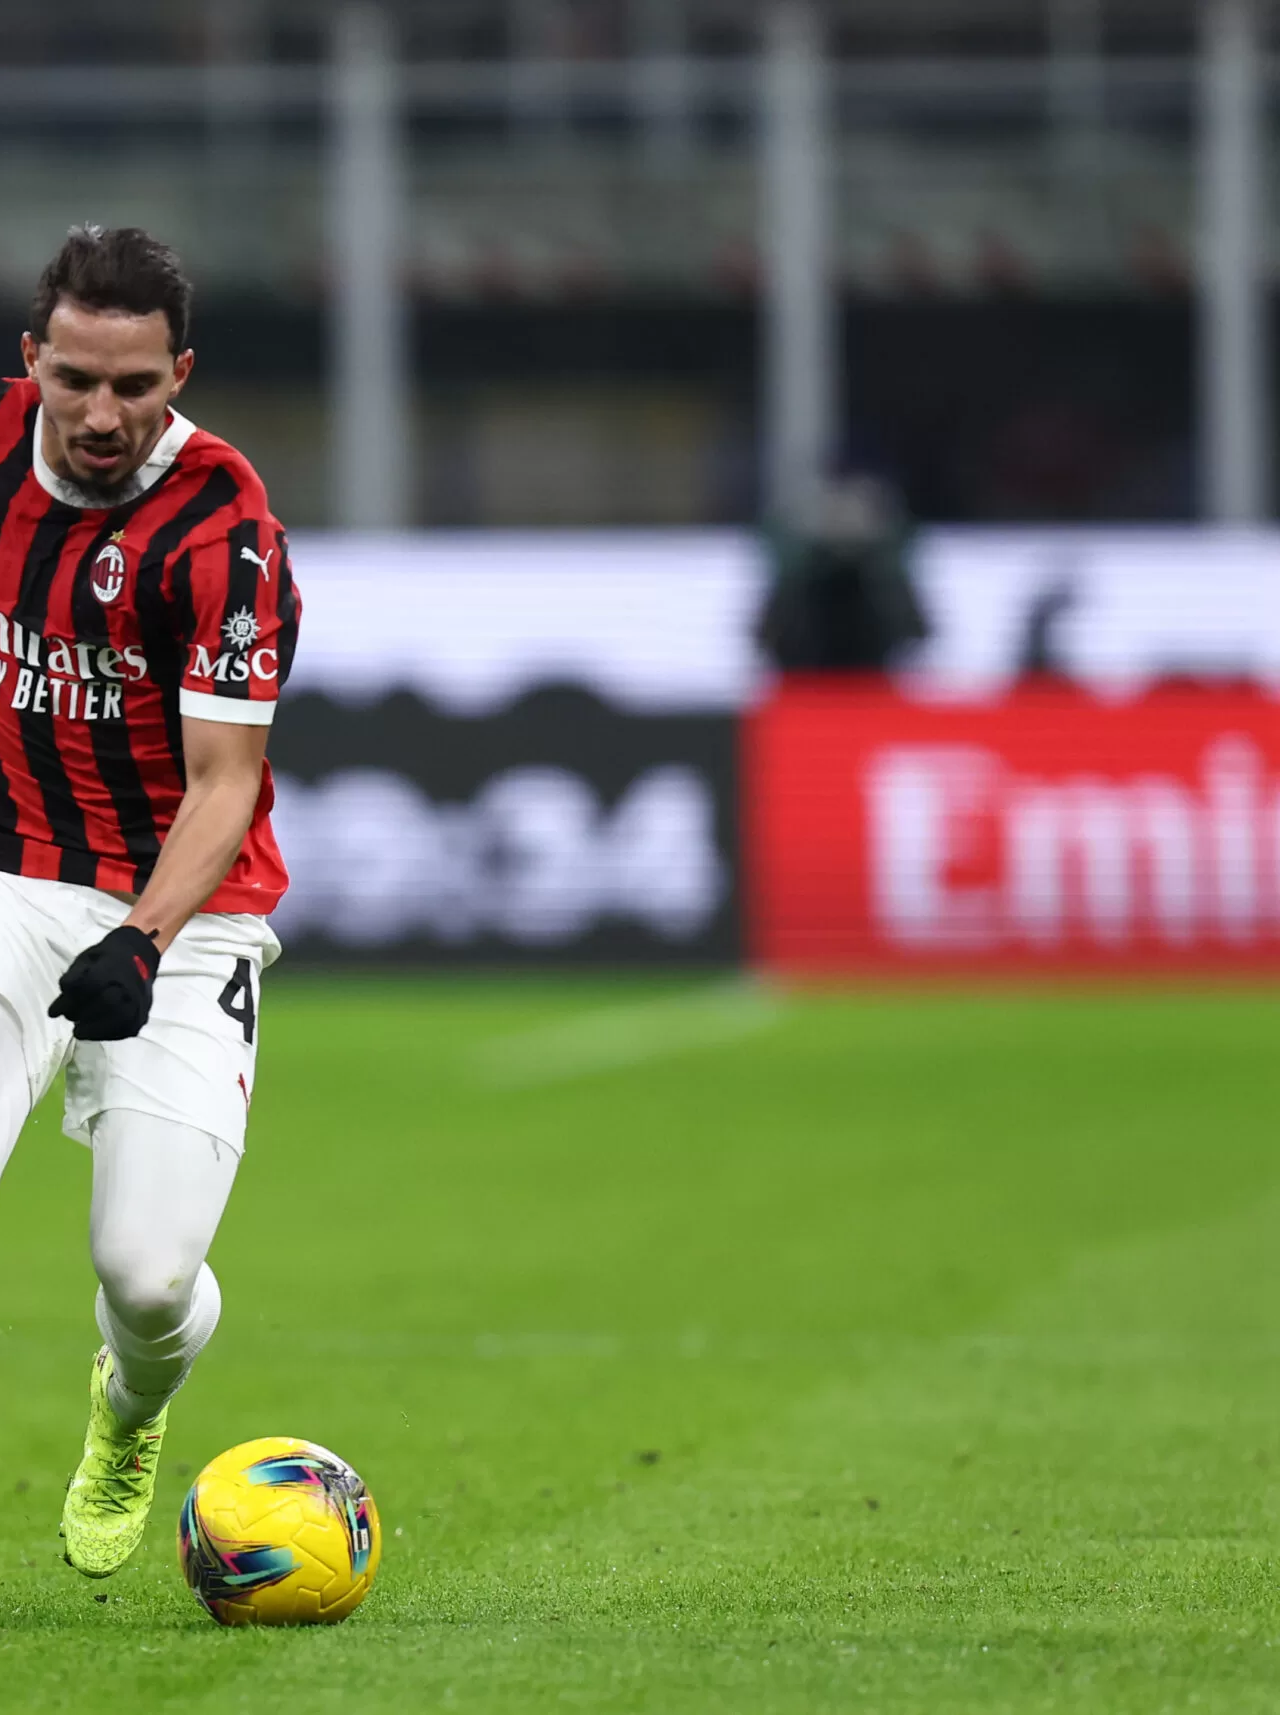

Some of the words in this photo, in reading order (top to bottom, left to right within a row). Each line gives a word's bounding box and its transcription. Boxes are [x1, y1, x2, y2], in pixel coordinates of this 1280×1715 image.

[11, 667, 123, 721] BETTER
[189, 644, 278, 682] MSC
[863, 733, 1280, 952] Emi
[217, 957, 255, 1046] 4
